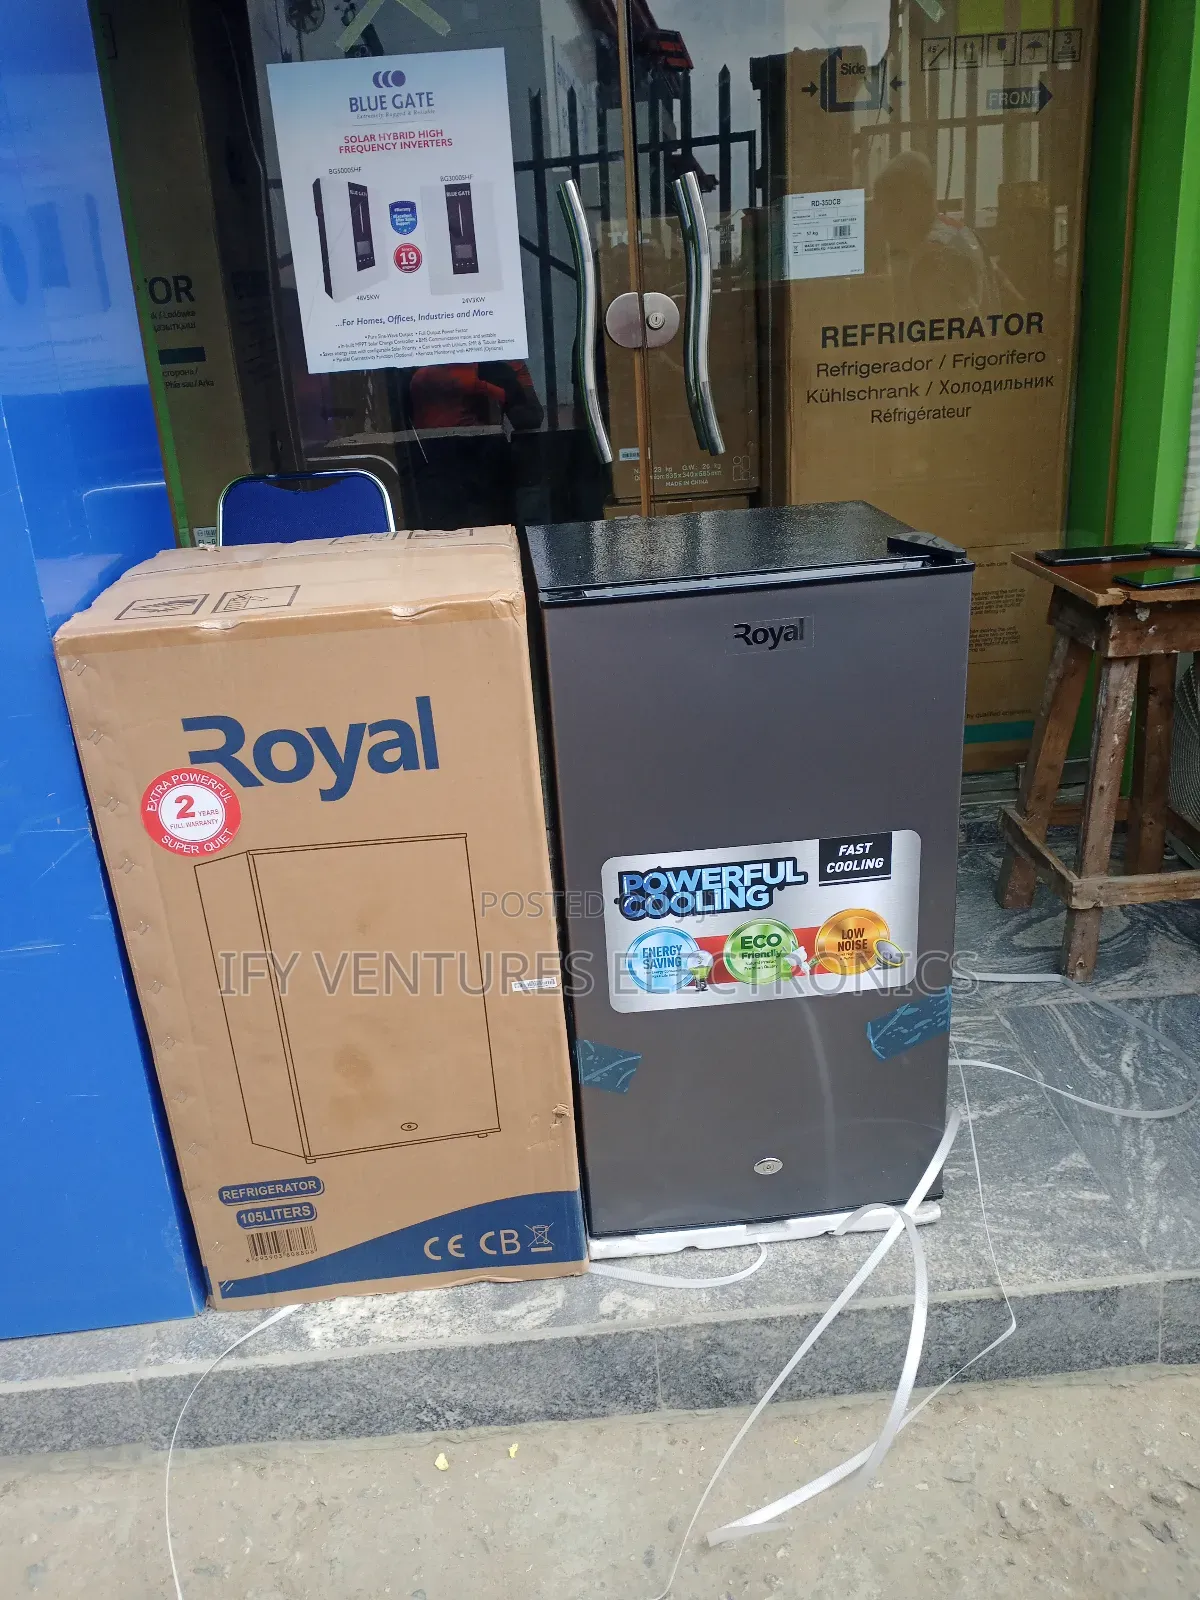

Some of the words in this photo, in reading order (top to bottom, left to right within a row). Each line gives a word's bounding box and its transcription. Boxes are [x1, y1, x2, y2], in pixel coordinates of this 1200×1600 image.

[840, 63, 866, 75] Side
[348, 95, 388, 113] BLUE
[392, 91, 435, 109] GATE
[988, 89, 1041, 106] FRONT
[344, 134, 376, 144] SOLAR
[379, 131, 416, 142] HYBRID
[418, 129, 443, 139] HIGH
[339, 142, 397, 154] FREQUENCY
[400, 138, 453, 150] INVERTERS
[400, 251, 417, 265] 19
[144, 274, 196, 305] OR
[356, 317, 386, 325] Homes,
[387, 314, 416, 325] Offices,
[418, 311, 455, 321] Industries
[456, 309, 471, 318] and
[472, 308, 494, 317] More
[821, 311, 1044, 349] REFRIGERATOR
[816, 356, 933, 379] Refrigerador
[938, 354, 946, 370] /
[952, 349, 1046, 371] Frigorifero
[806, 382, 919, 404] Kühlschrank
[925, 381, 933, 396] /
[939, 375, 1055, 396] Холодильник
[870, 405, 972, 425] Réfrigérateur
[733, 617, 804, 650] Royal
[181, 695, 440, 802] Royal
[146, 780, 172, 812] EXTRA
[171, 772, 232, 803] POWERFUL
[174, 794, 196, 819] 2
[198, 808, 219, 816] YEARS
[186, 819, 219, 828] WARRANTY
[161, 835, 200, 854] SUPER
[204, 828, 233, 852] QUIET
[838, 841, 873, 857] FAST
[826, 857, 884, 874] COOLING
[621, 858, 805, 897] POWERFUL
[622, 884, 771, 920] COOLING
[740, 933, 782, 949] ECO
[841, 927, 865, 941] LOW
[642, 944, 683, 959] ENERGY
[837, 938, 868, 952] NOISE
[642, 956, 682, 970] SAVING
[741, 949, 782, 960] Friendly
[222, 1180, 317, 1200] REFRIGERATOR
[240, 1205, 311, 1224] 105LITERS
[424, 1233, 465, 1261] CE
[479, 1228, 521, 1256] CB
